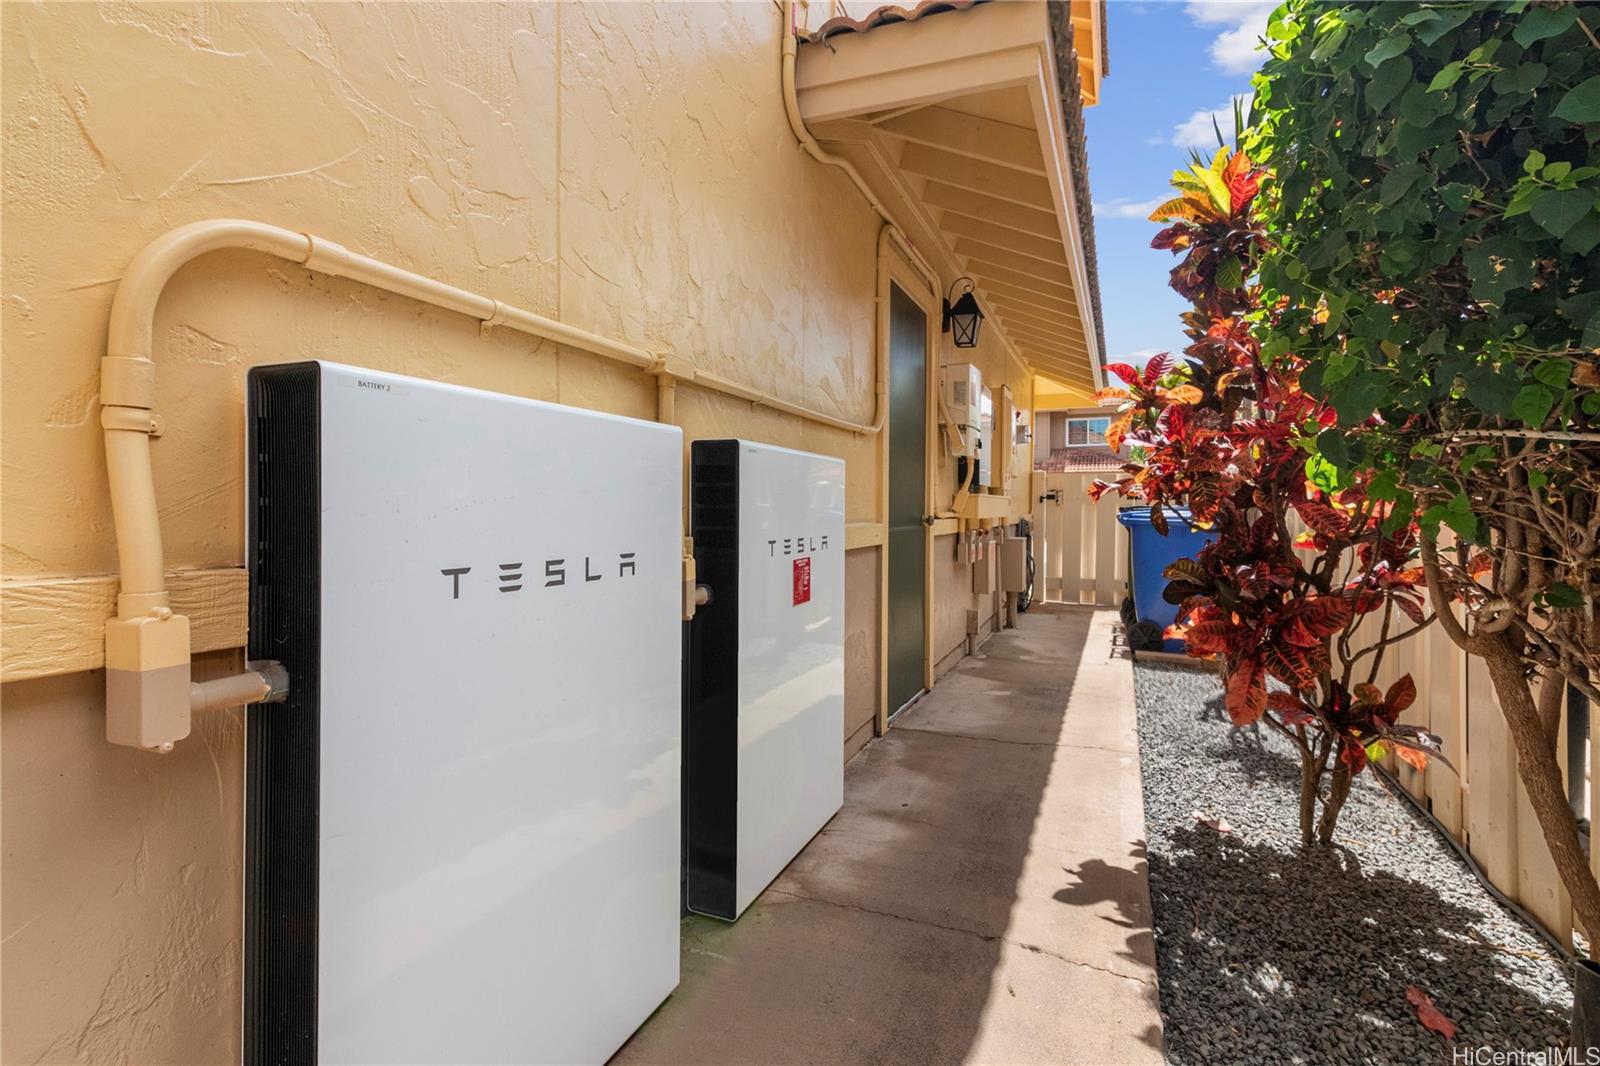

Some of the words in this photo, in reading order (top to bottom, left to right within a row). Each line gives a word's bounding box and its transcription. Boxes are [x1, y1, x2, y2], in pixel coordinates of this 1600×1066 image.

[358, 380, 385, 390] BATTERY
[768, 536, 828, 557] TESLA
[441, 552, 635, 599] TESLA
